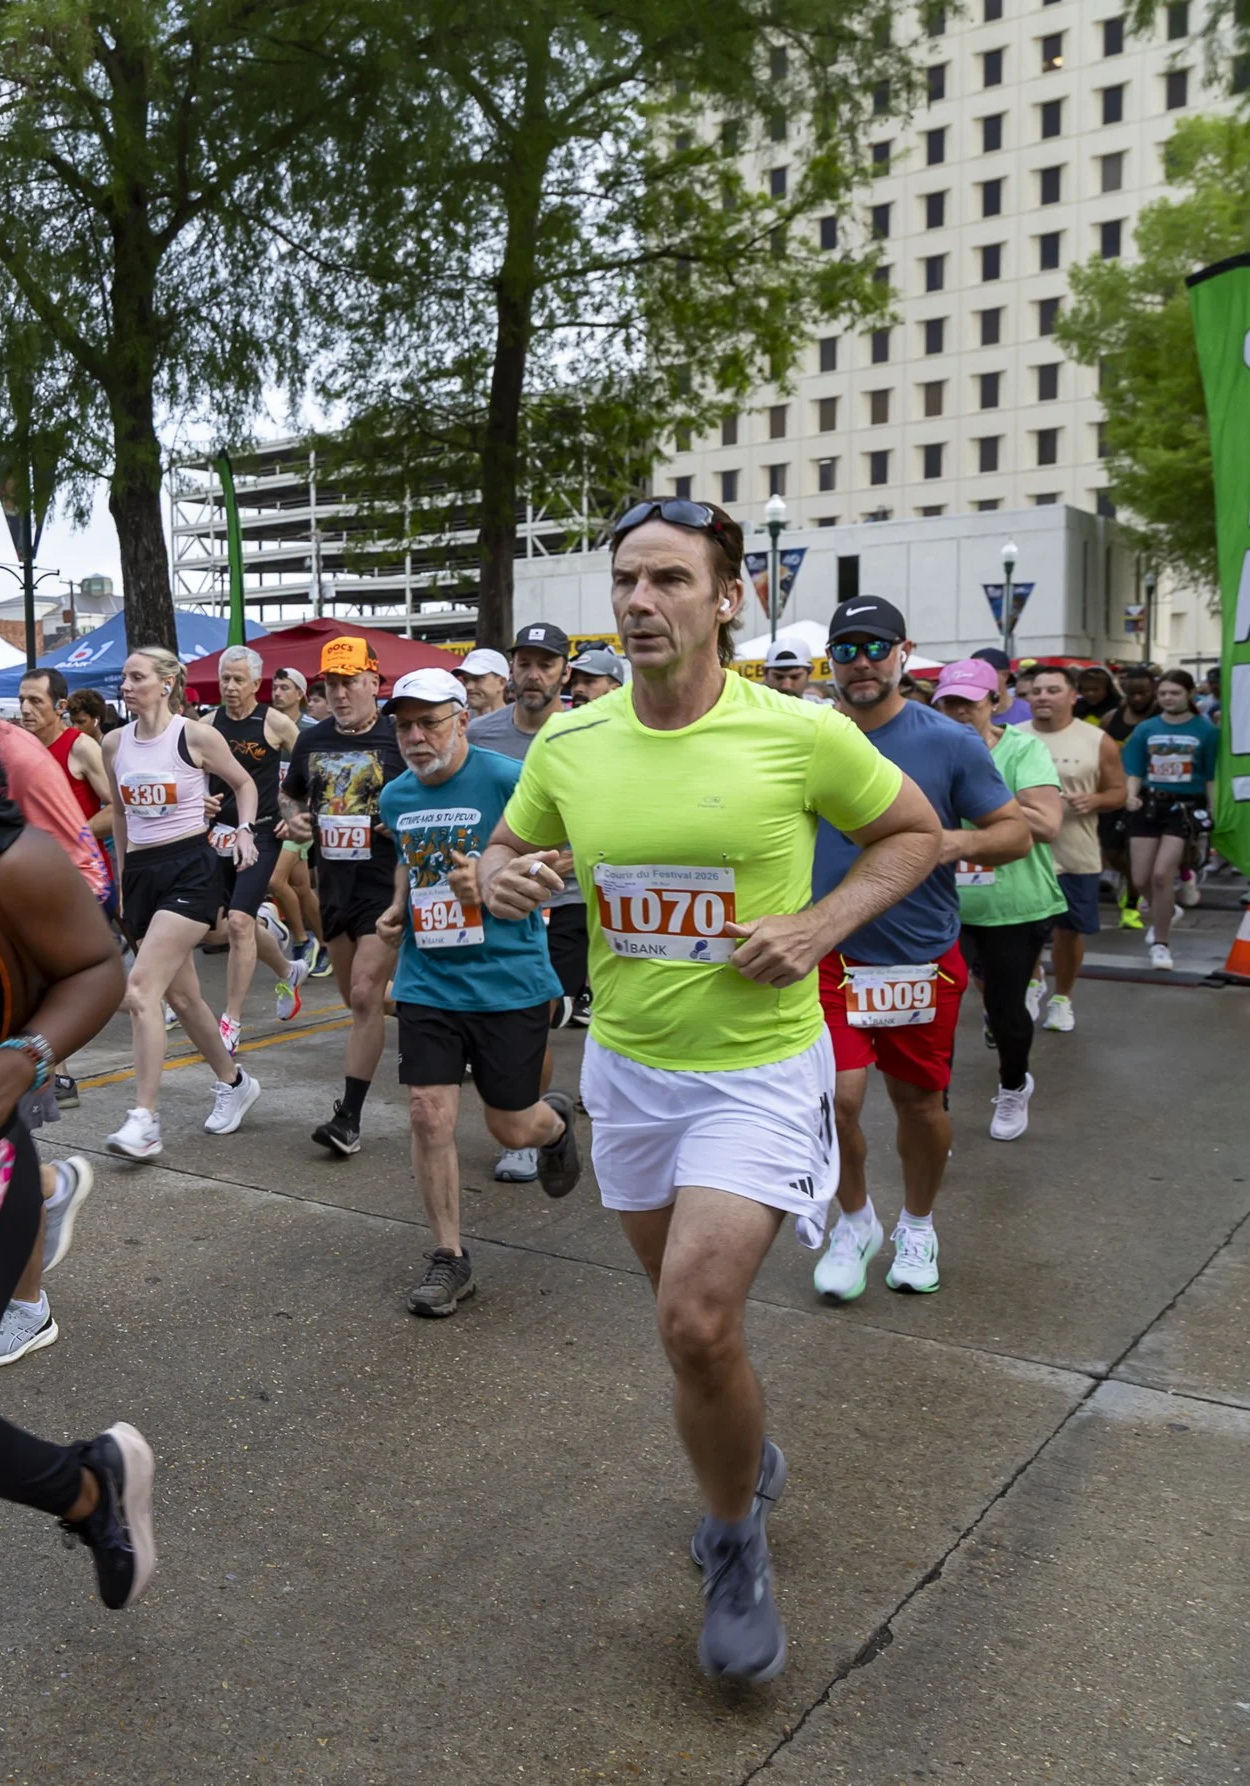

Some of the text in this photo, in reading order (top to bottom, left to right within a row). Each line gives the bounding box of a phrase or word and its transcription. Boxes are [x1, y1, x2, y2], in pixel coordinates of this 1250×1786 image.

[129, 784, 166, 805] 330
[320, 827, 366, 848] 1079
[604, 869, 719, 881] Courir du Festival 2026
[421, 902, 465, 930] 594
[603, 889, 725, 936] 1070
[852, 981, 932, 1011] 1009
